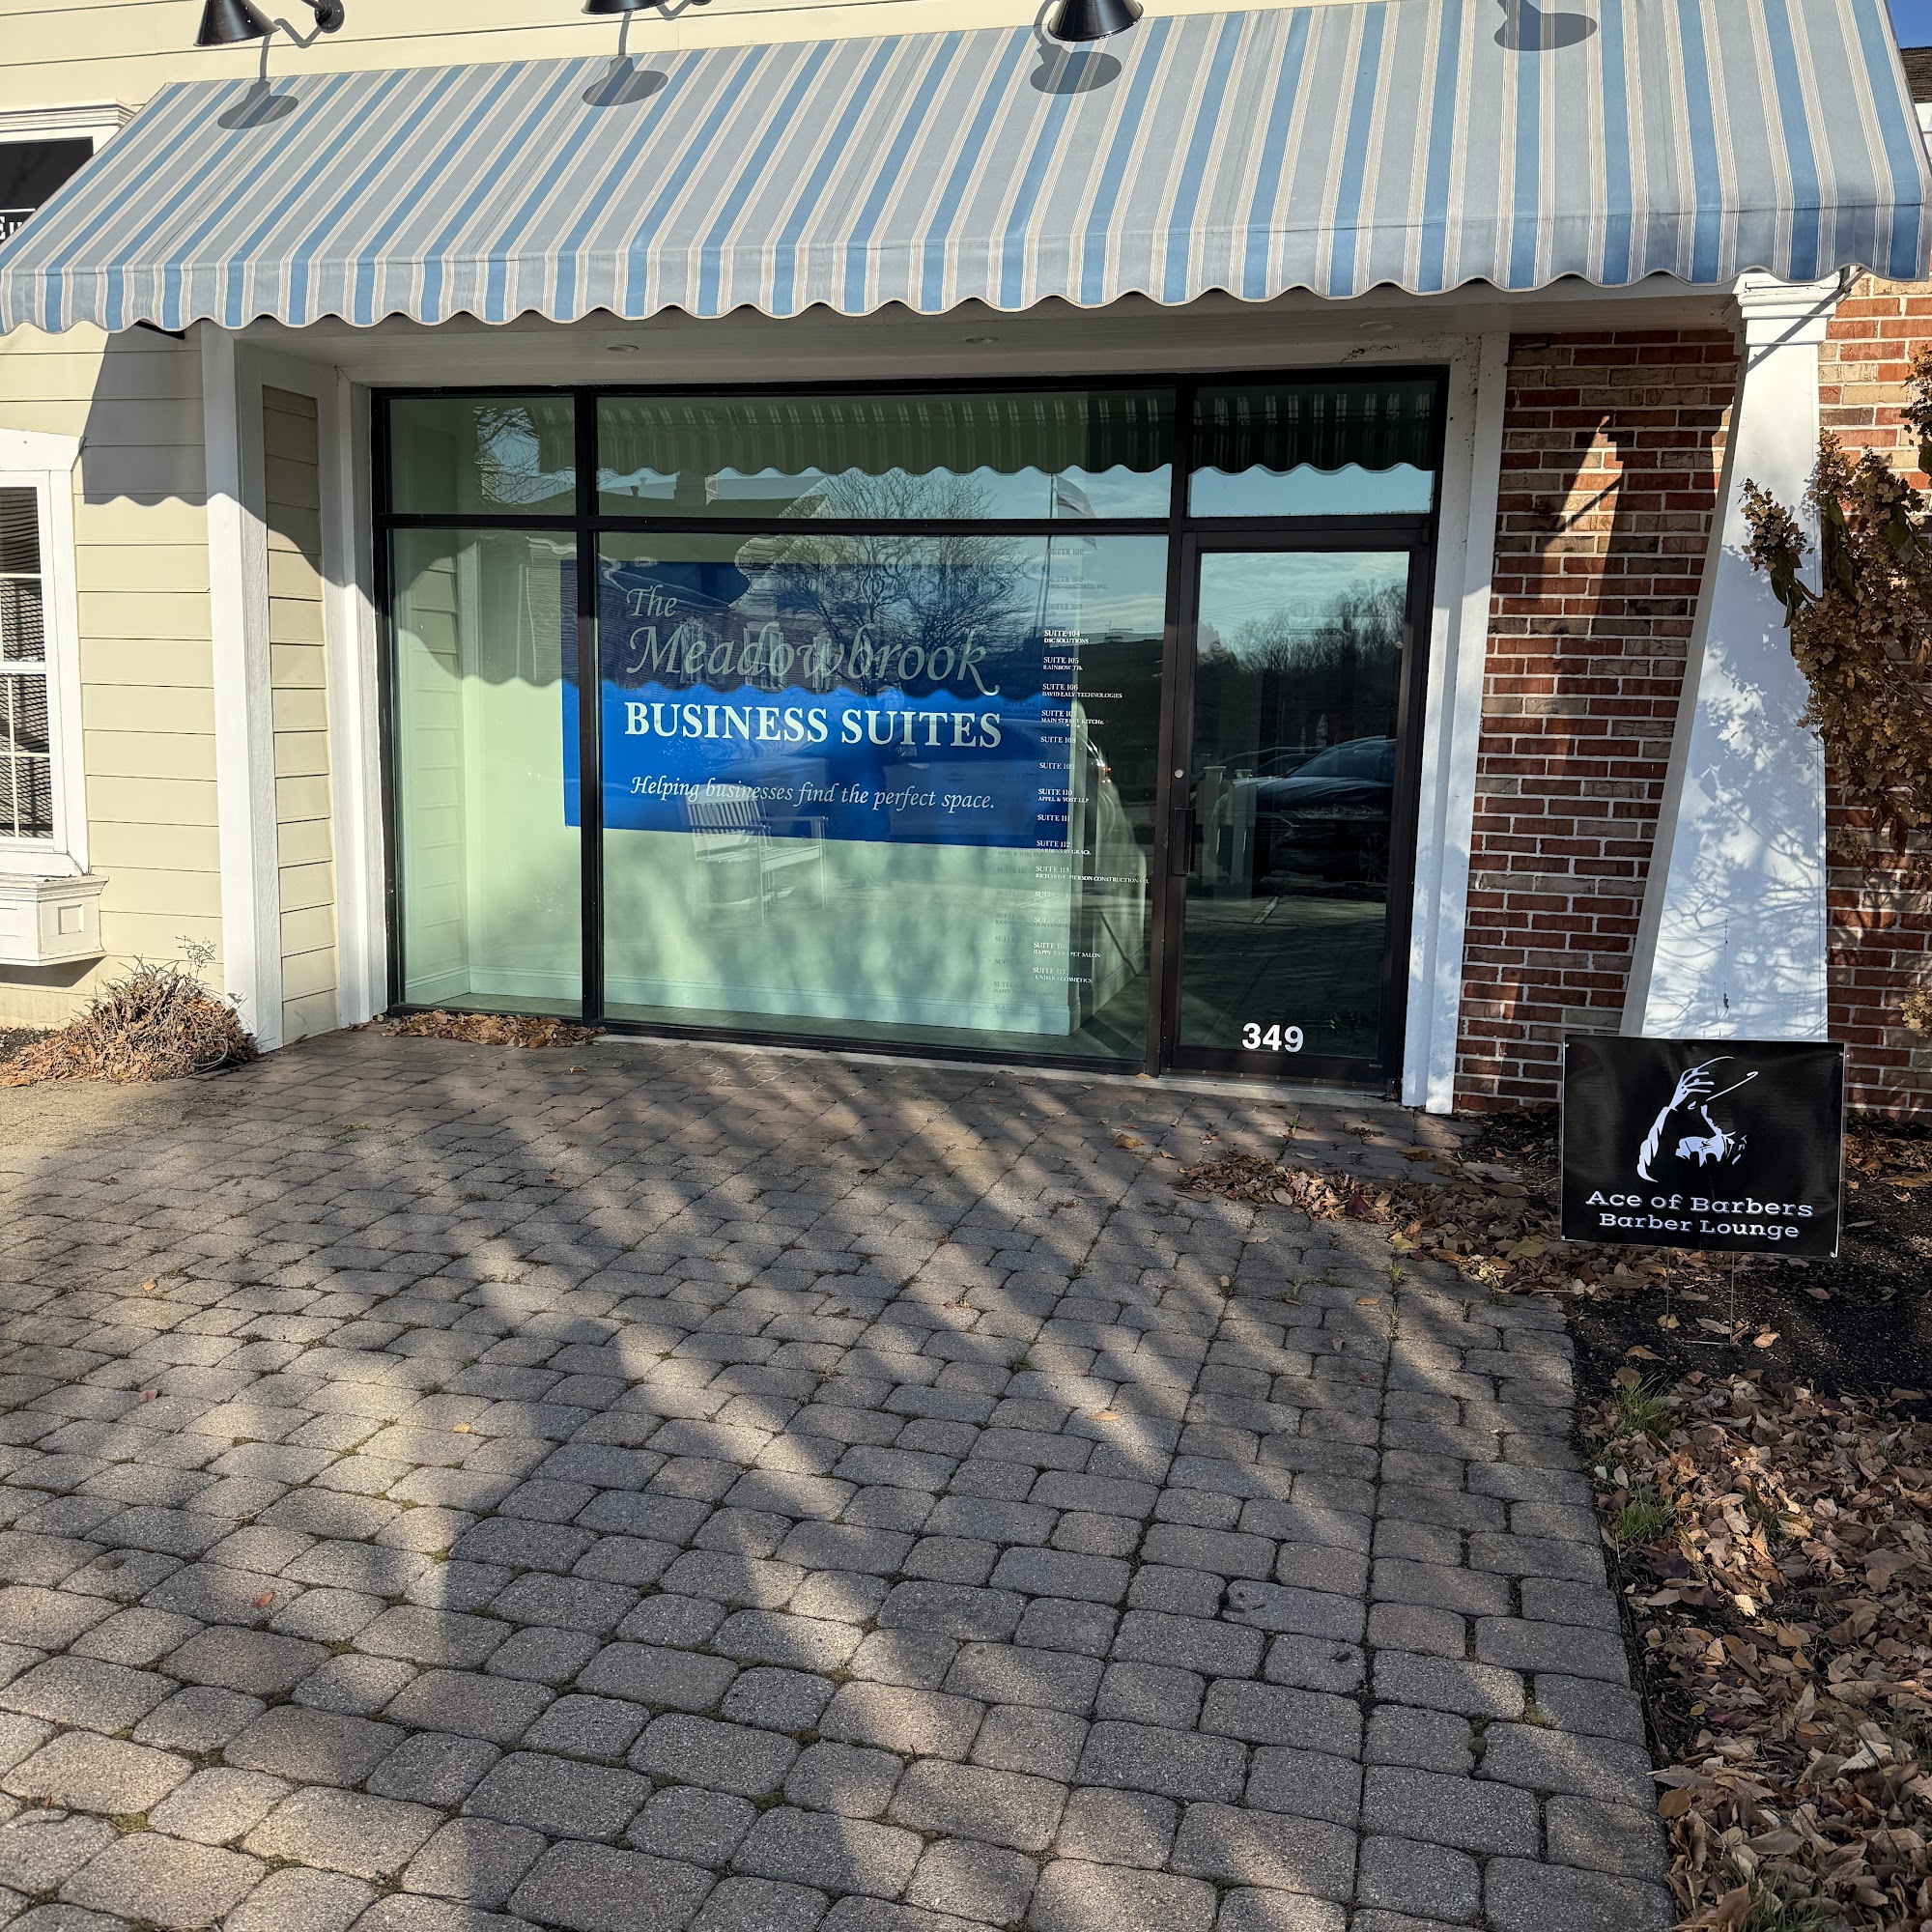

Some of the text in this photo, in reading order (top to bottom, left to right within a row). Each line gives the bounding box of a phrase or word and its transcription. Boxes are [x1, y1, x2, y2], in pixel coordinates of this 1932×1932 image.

[626, 583, 678, 618] The
[626, 620, 1000, 696] Meadowbrook
[624, 701, 1002, 749] BUSINESS SUITES
[630, 776, 995, 814] Helping businesses find the perfect space.
[1241, 1022, 1304, 1053] 349
[1585, 1190, 1814, 1218] Ace of Barbers
[1599, 1213, 1801, 1241] Barber Lounge
